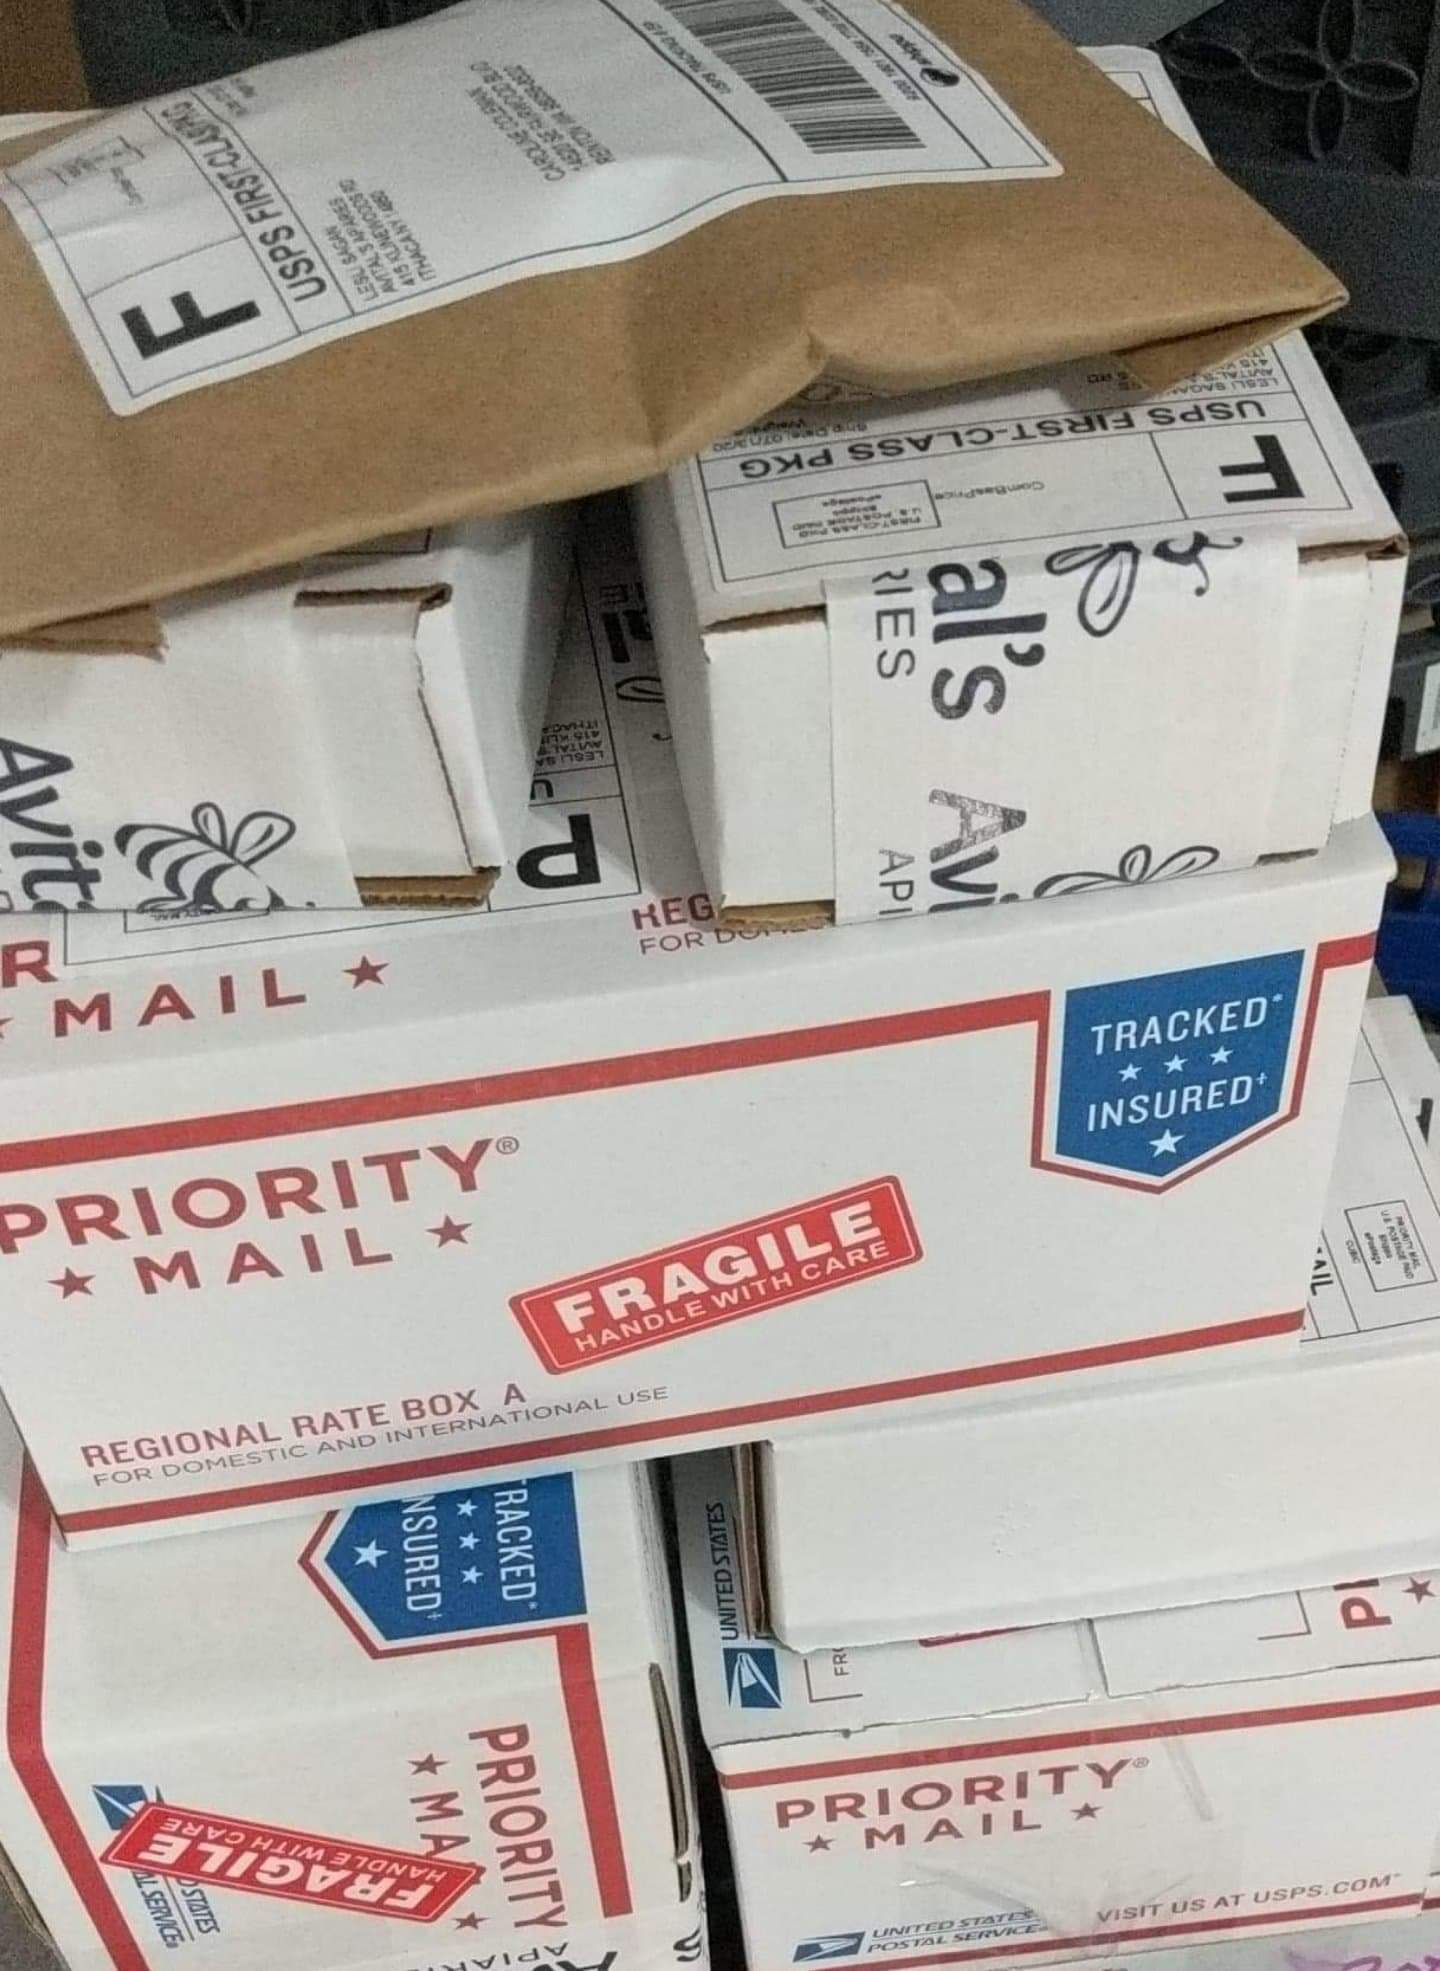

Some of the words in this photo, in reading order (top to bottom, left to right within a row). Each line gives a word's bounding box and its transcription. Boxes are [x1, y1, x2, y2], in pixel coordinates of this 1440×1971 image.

[259, 225, 327, 302] USPS
[393, 264, 416, 285] 415
[120, 291, 261, 360] F
[848, 411, 1135, 461] FIRST-CLASS
[1147, 400, 1266, 426] USPS
[739, 448, 833, 478] PKG
[1219, 434, 1305, 504] F
[516, 813, 601, 890] P
[639, 931, 704, 955] FOR
[53, 967, 307, 1037] MAIL
[134, 1227, 393, 1294] MAIL
[552, 1201, 882, 1335] FRAGILE
[574, 1300, 707, 1353] HANDLE
[711, 1273, 794, 1310] WITH
[801, 1240, 890, 1280] CARE
[80, 1419, 282, 1468] REGIONAL
[291, 1404, 391, 1440] RATE
[402, 1389, 479, 1422] BOX
[502, 1383, 526, 1405] A
[93, 1467, 153, 1487] FOR
[161, 1444, 310, 1477] DOMESTIC
[317, 1435, 377, 1458] AND
[384, 1398, 610, 1446] INTERNATIONAL
[617, 1386, 669, 1407] USE
[706, 1502, 731, 1566] STATES
[714, 1568, 740, 1641] UNITED
[160, 1817, 246, 1848] CARE
[251, 1838, 327, 1865] WITH
[468, 1724, 568, 1928] PRIORITY
[864, 1809, 1042, 1850] MAIL
[138, 1833, 435, 1910] FRAGILE
[330, 1851, 448, 1882] HANDLE
[181, 1888, 221, 1934] STATES
[871, 1918, 956, 1938] UNITED
[1097, 1903, 1163, 1922] VISIT
[1171, 1898, 1205, 1914] US
[1213, 1893, 1246, 1909] AT
[867, 1934, 949, 1953] POSTAL
